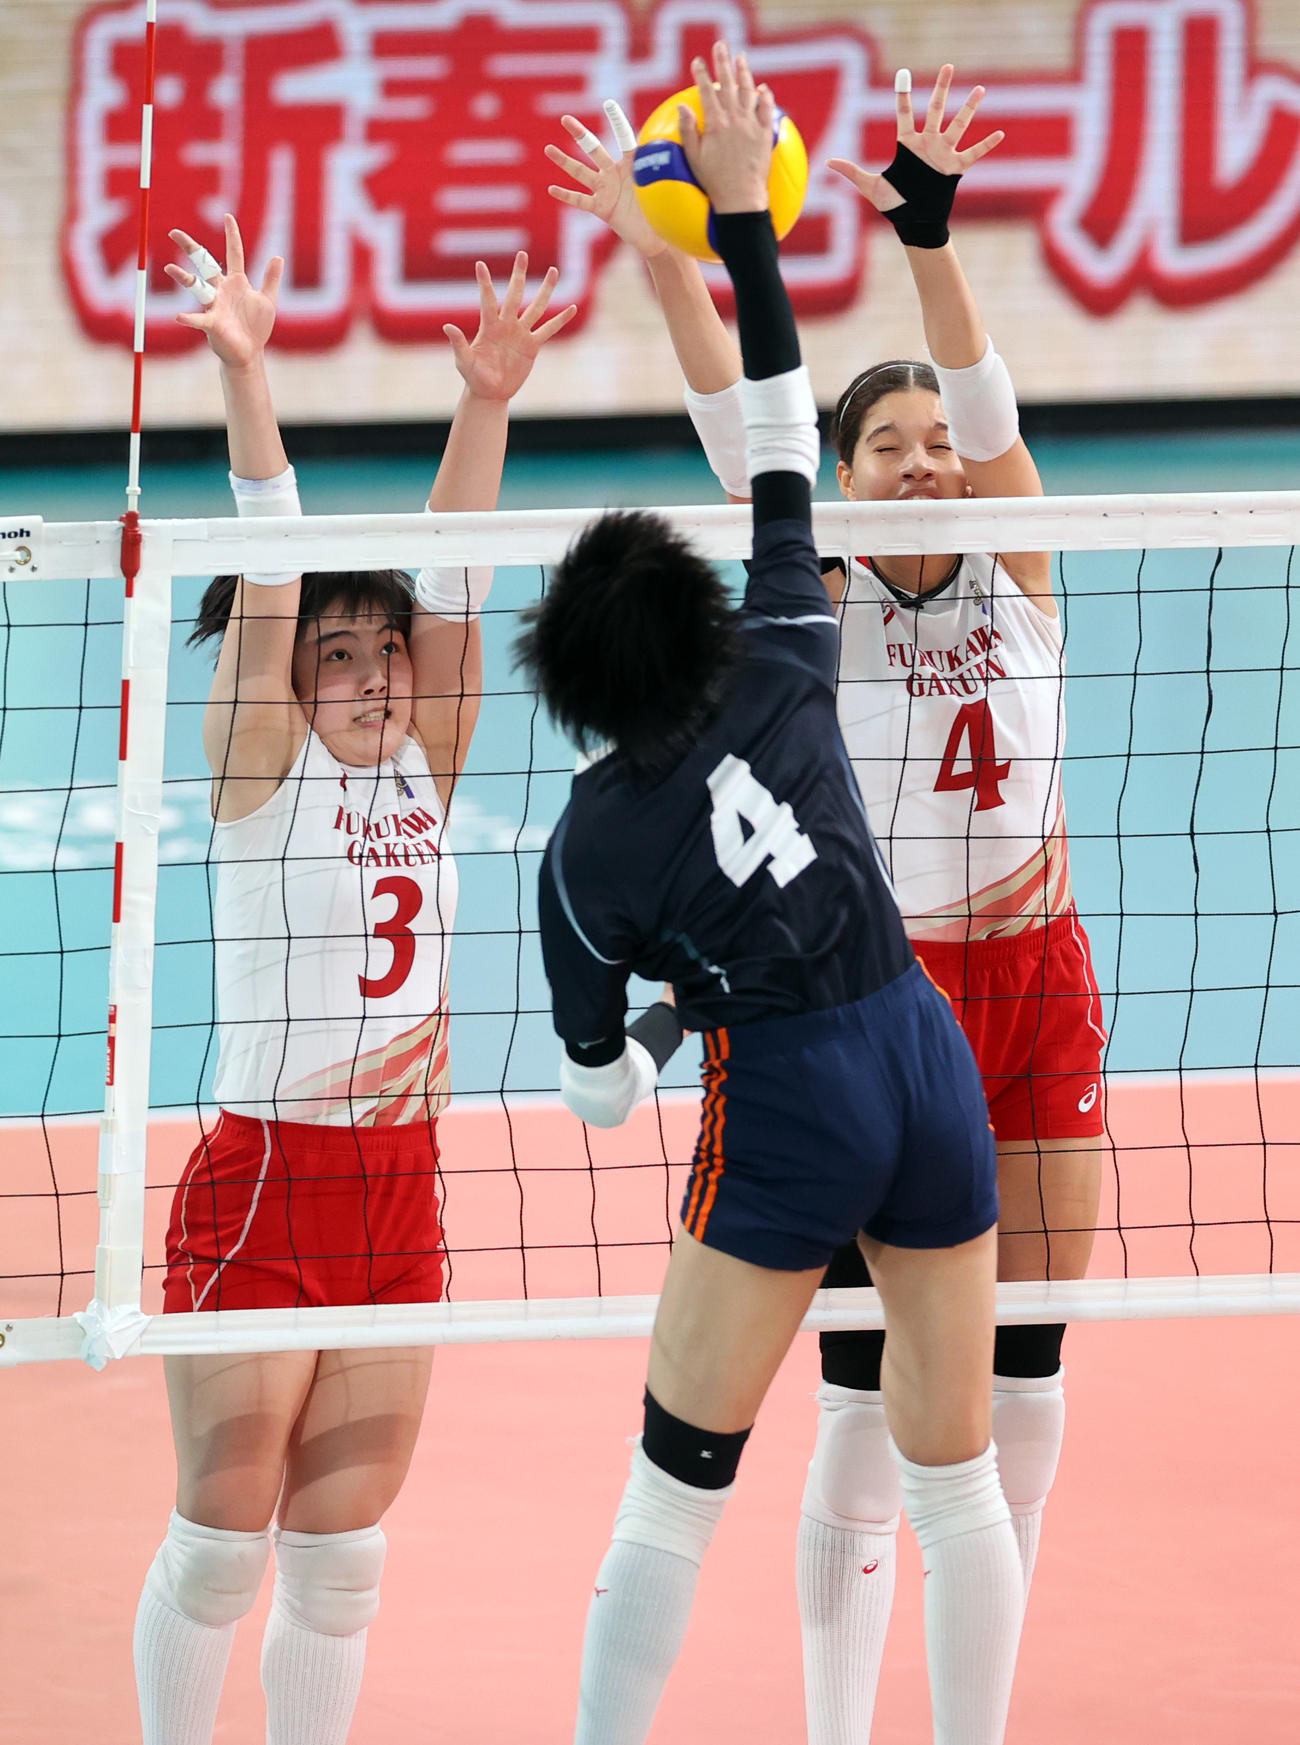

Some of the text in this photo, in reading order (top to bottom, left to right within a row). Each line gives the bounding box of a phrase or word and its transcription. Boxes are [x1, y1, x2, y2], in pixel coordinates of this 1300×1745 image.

[933, 698, 1011, 812] 4
[706, 752, 819, 889] 4
[358, 876, 423, 998] 3
